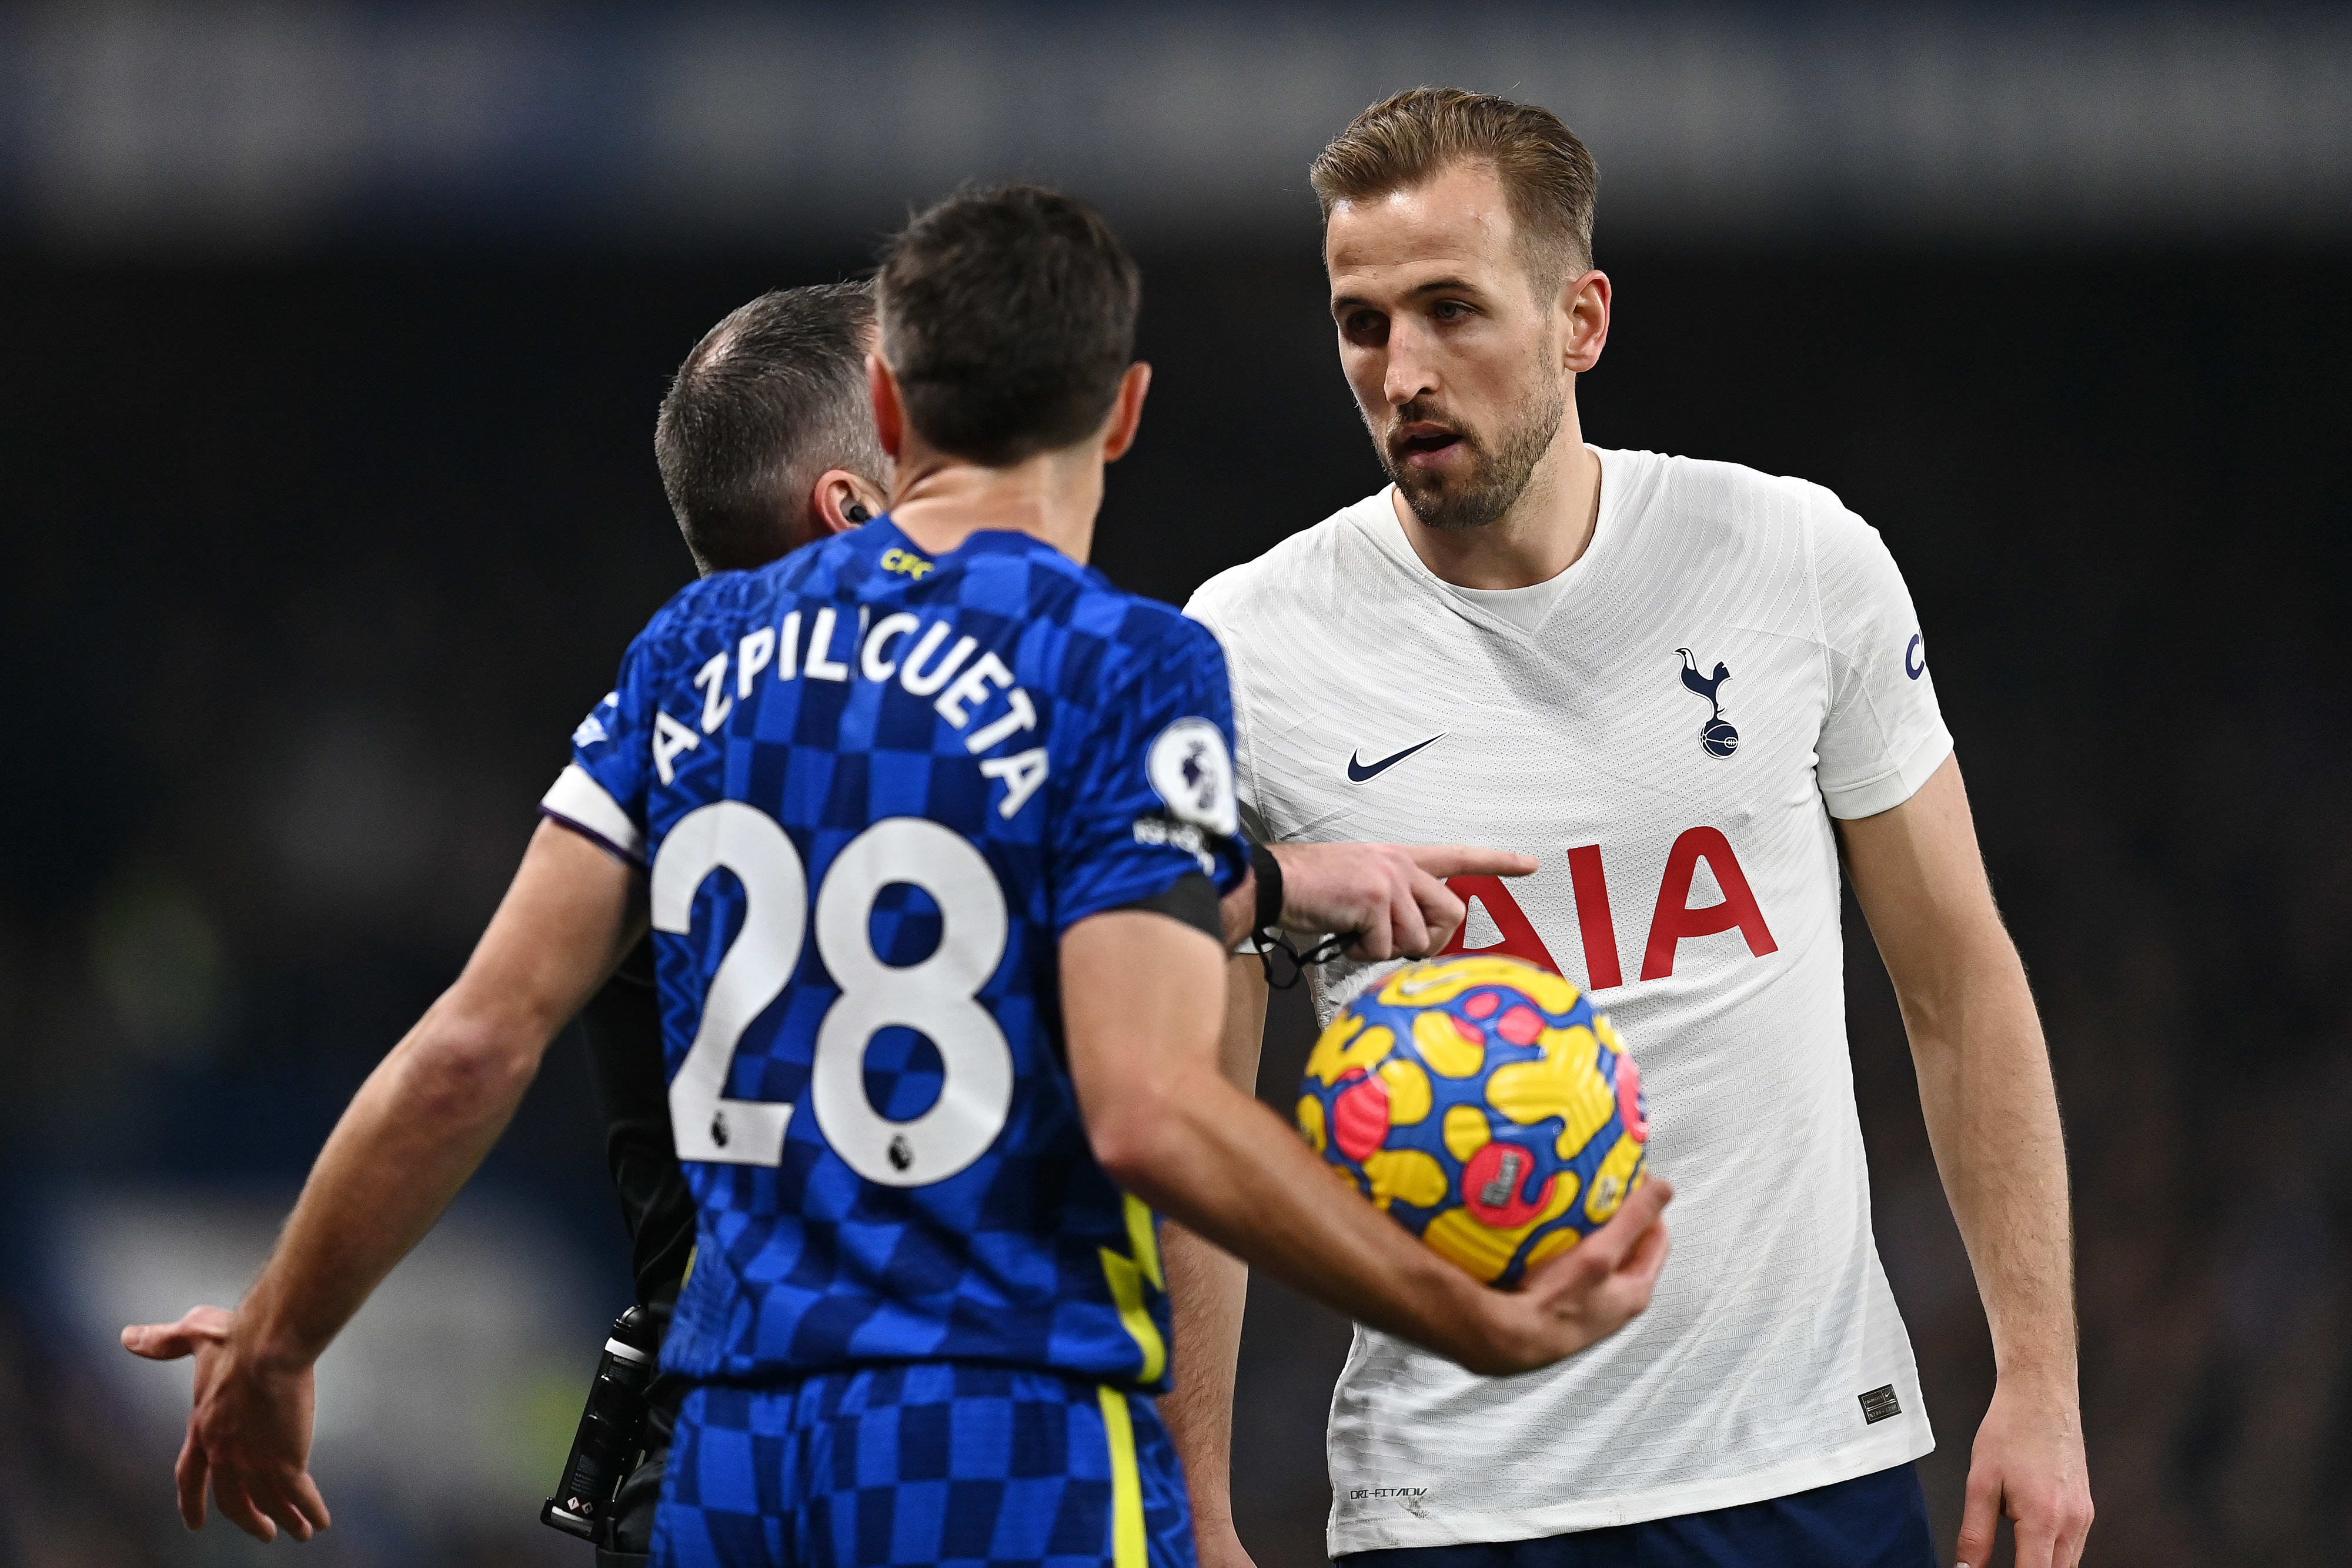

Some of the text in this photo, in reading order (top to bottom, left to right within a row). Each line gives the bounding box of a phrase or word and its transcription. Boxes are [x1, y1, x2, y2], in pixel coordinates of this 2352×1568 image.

[881, 547, 934, 581] CFC
[1437, 826, 1779, 991] AIA
[650, 800, 1014, 1187] 28
